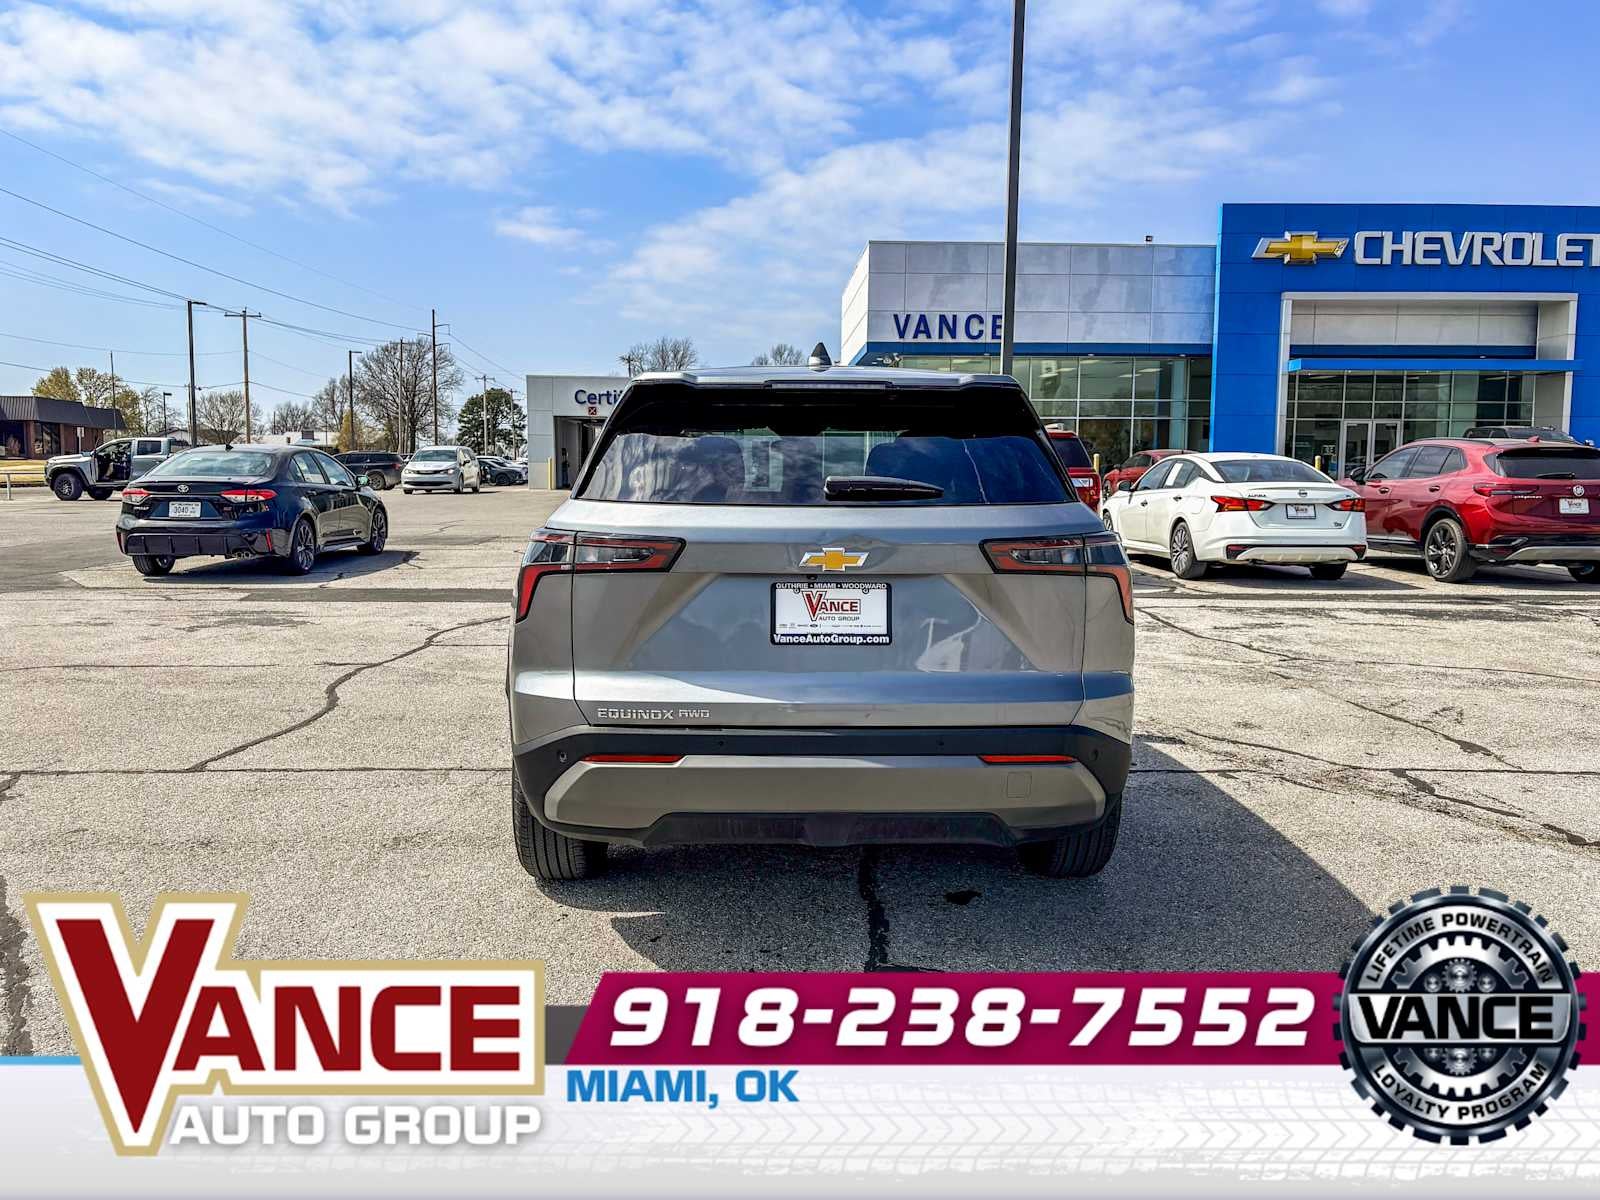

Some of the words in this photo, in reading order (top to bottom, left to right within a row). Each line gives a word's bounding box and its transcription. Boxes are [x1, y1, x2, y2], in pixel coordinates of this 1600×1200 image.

[1354, 230, 1600, 267] CHEVROLET
[893, 313, 1003, 340] VANCE
[803, 592, 859, 619] VANCE
[773, 634, 890, 645] VanceAutoGroup.com
[597, 708, 674, 720] EQUINOX
[679, 709, 710, 718] AWD
